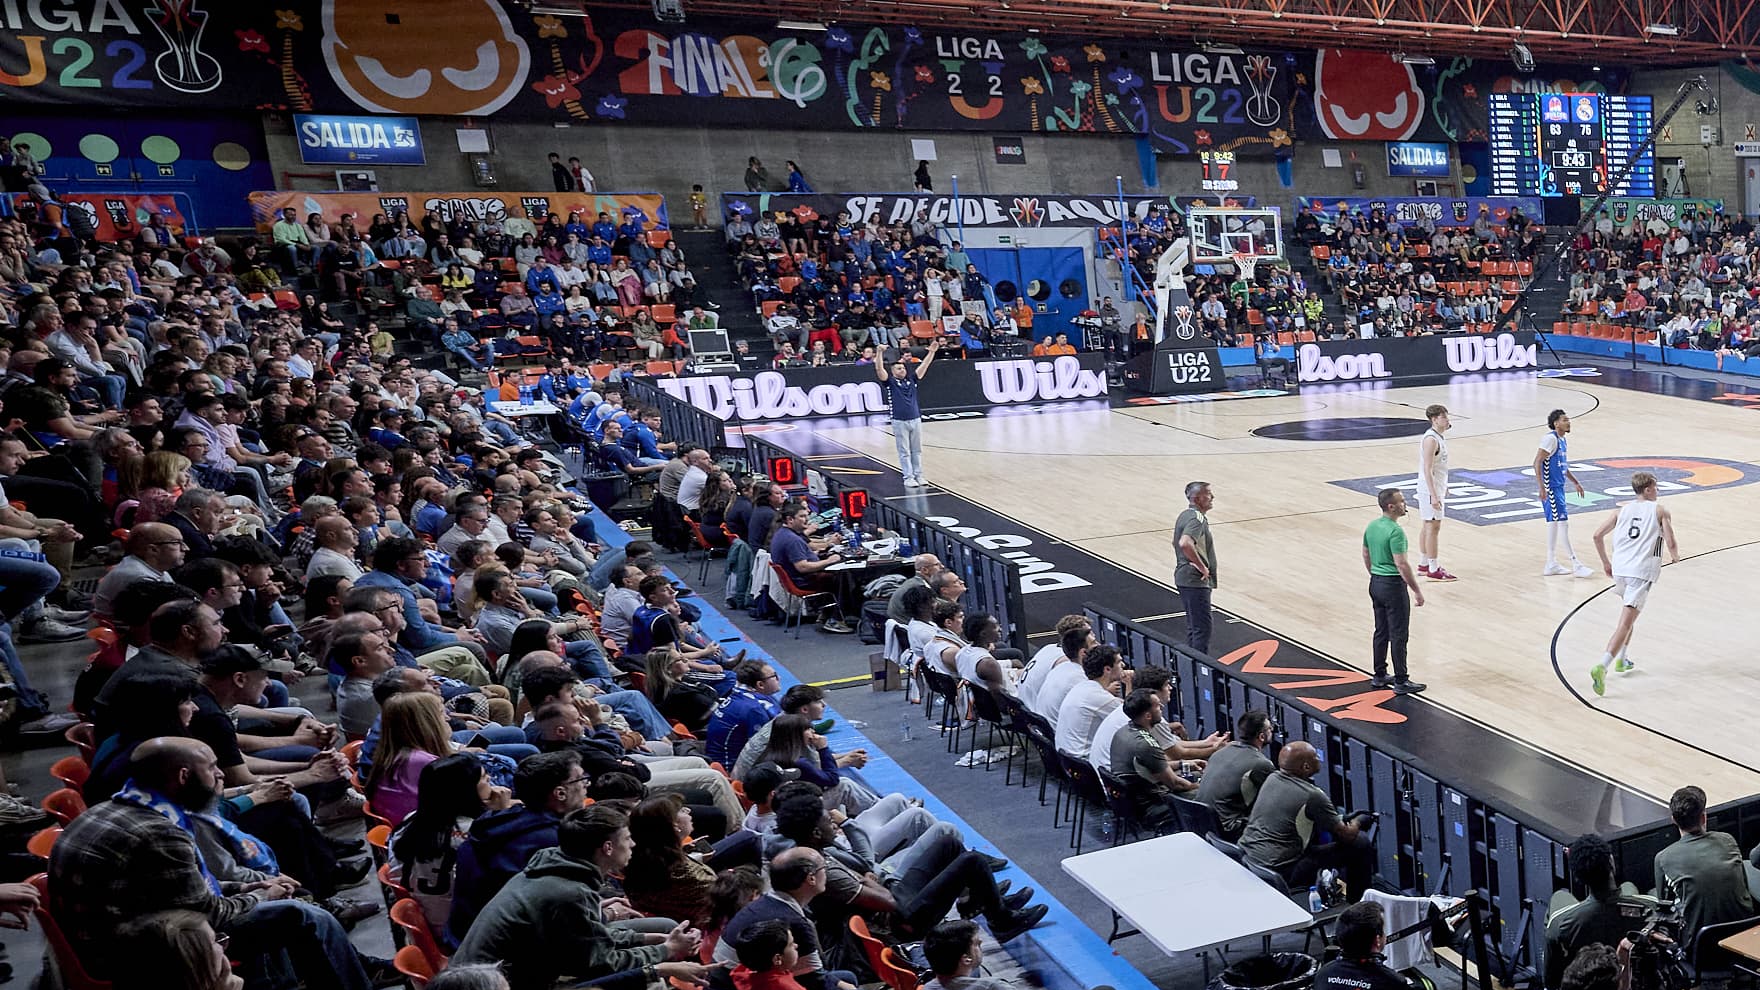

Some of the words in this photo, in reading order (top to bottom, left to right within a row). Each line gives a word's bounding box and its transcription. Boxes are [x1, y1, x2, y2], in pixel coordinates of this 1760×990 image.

[0, 0, 141, 34] IGA
[936, 36, 1004, 59] LIGA
[1150, 51, 1241, 84] LIGA
[1153, 84, 1245, 123] U22
[302, 122, 391, 148] SALIDA
[1390, 147, 1433, 166] SALIDA
[381, 198, 407, 206] LIGA
[523, 198, 547, 206] LIGA
[846, 197, 882, 224] SE
[889, 197, 1011, 225] DECIDE
[1169, 352, 1209, 367] LIGA
[1170, 366, 1211, 383] U22
[657, 371, 889, 421] Wilson
[775, 458, 793, 481] 0
[1628, 518, 1642, 540] 6
[1327, 976, 1371, 990] voluntarios
